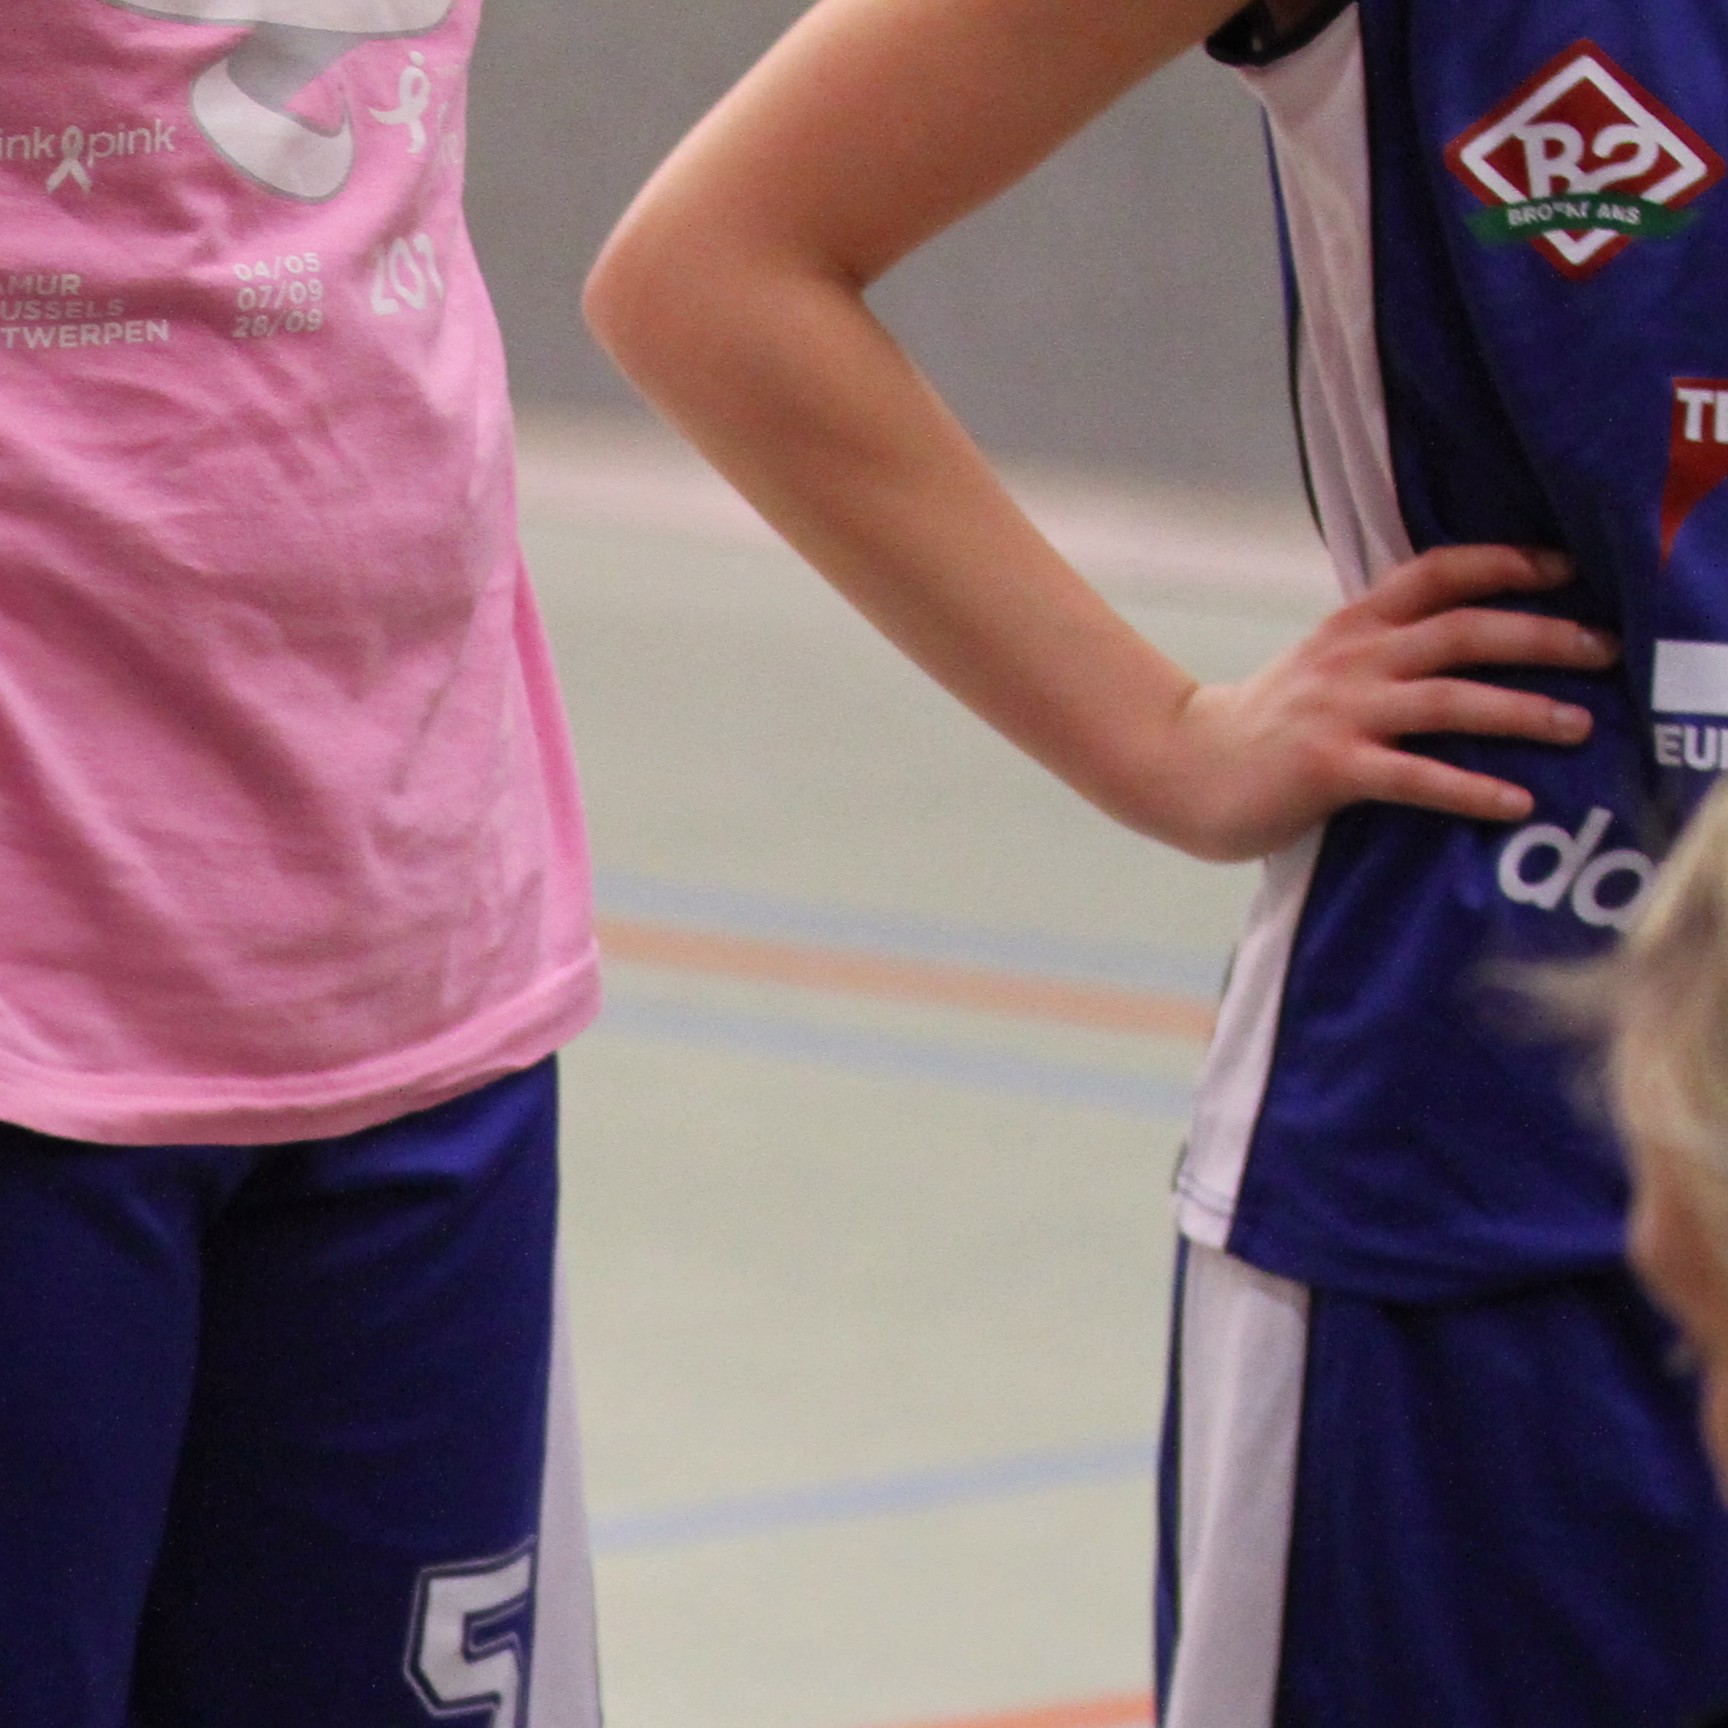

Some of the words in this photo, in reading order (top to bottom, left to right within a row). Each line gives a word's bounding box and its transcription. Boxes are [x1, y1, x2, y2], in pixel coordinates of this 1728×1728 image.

[87, 118, 176, 168] pink
[233, 252, 321, 281] 04/05
[237, 278, 323, 311] 07/09
[232, 308, 322, 338] 28/09
